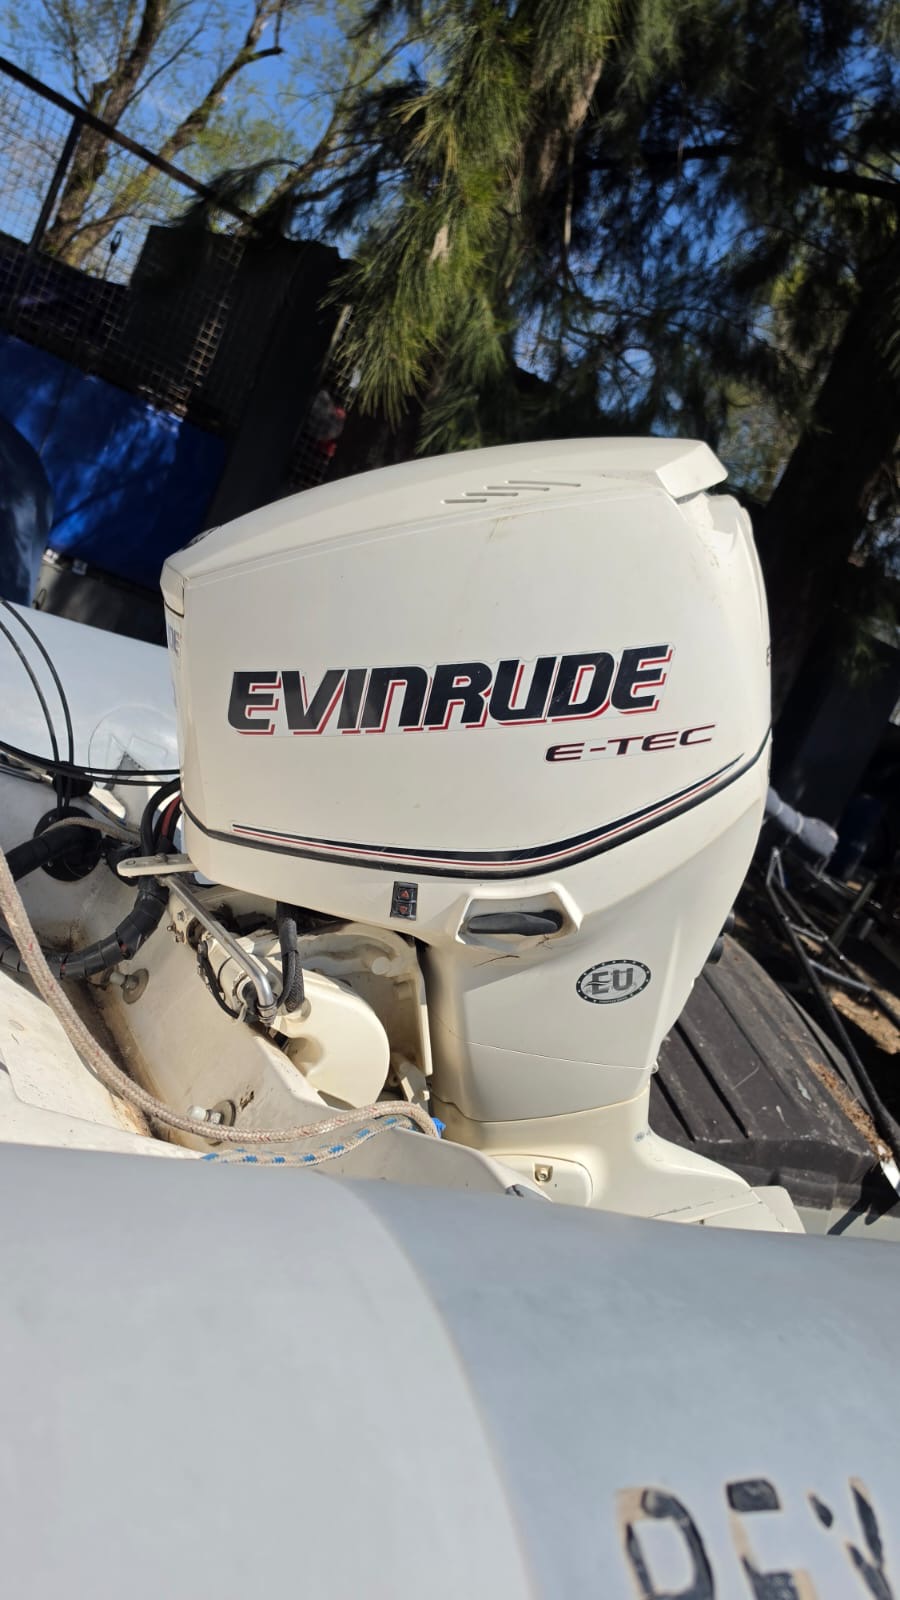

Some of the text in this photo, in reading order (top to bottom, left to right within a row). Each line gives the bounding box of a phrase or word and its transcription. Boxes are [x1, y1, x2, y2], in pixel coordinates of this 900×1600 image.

[227, 645, 673, 735] EVINRUDE
[545, 724, 716, 762] E-TEC
[590, 967, 634, 995] EU
